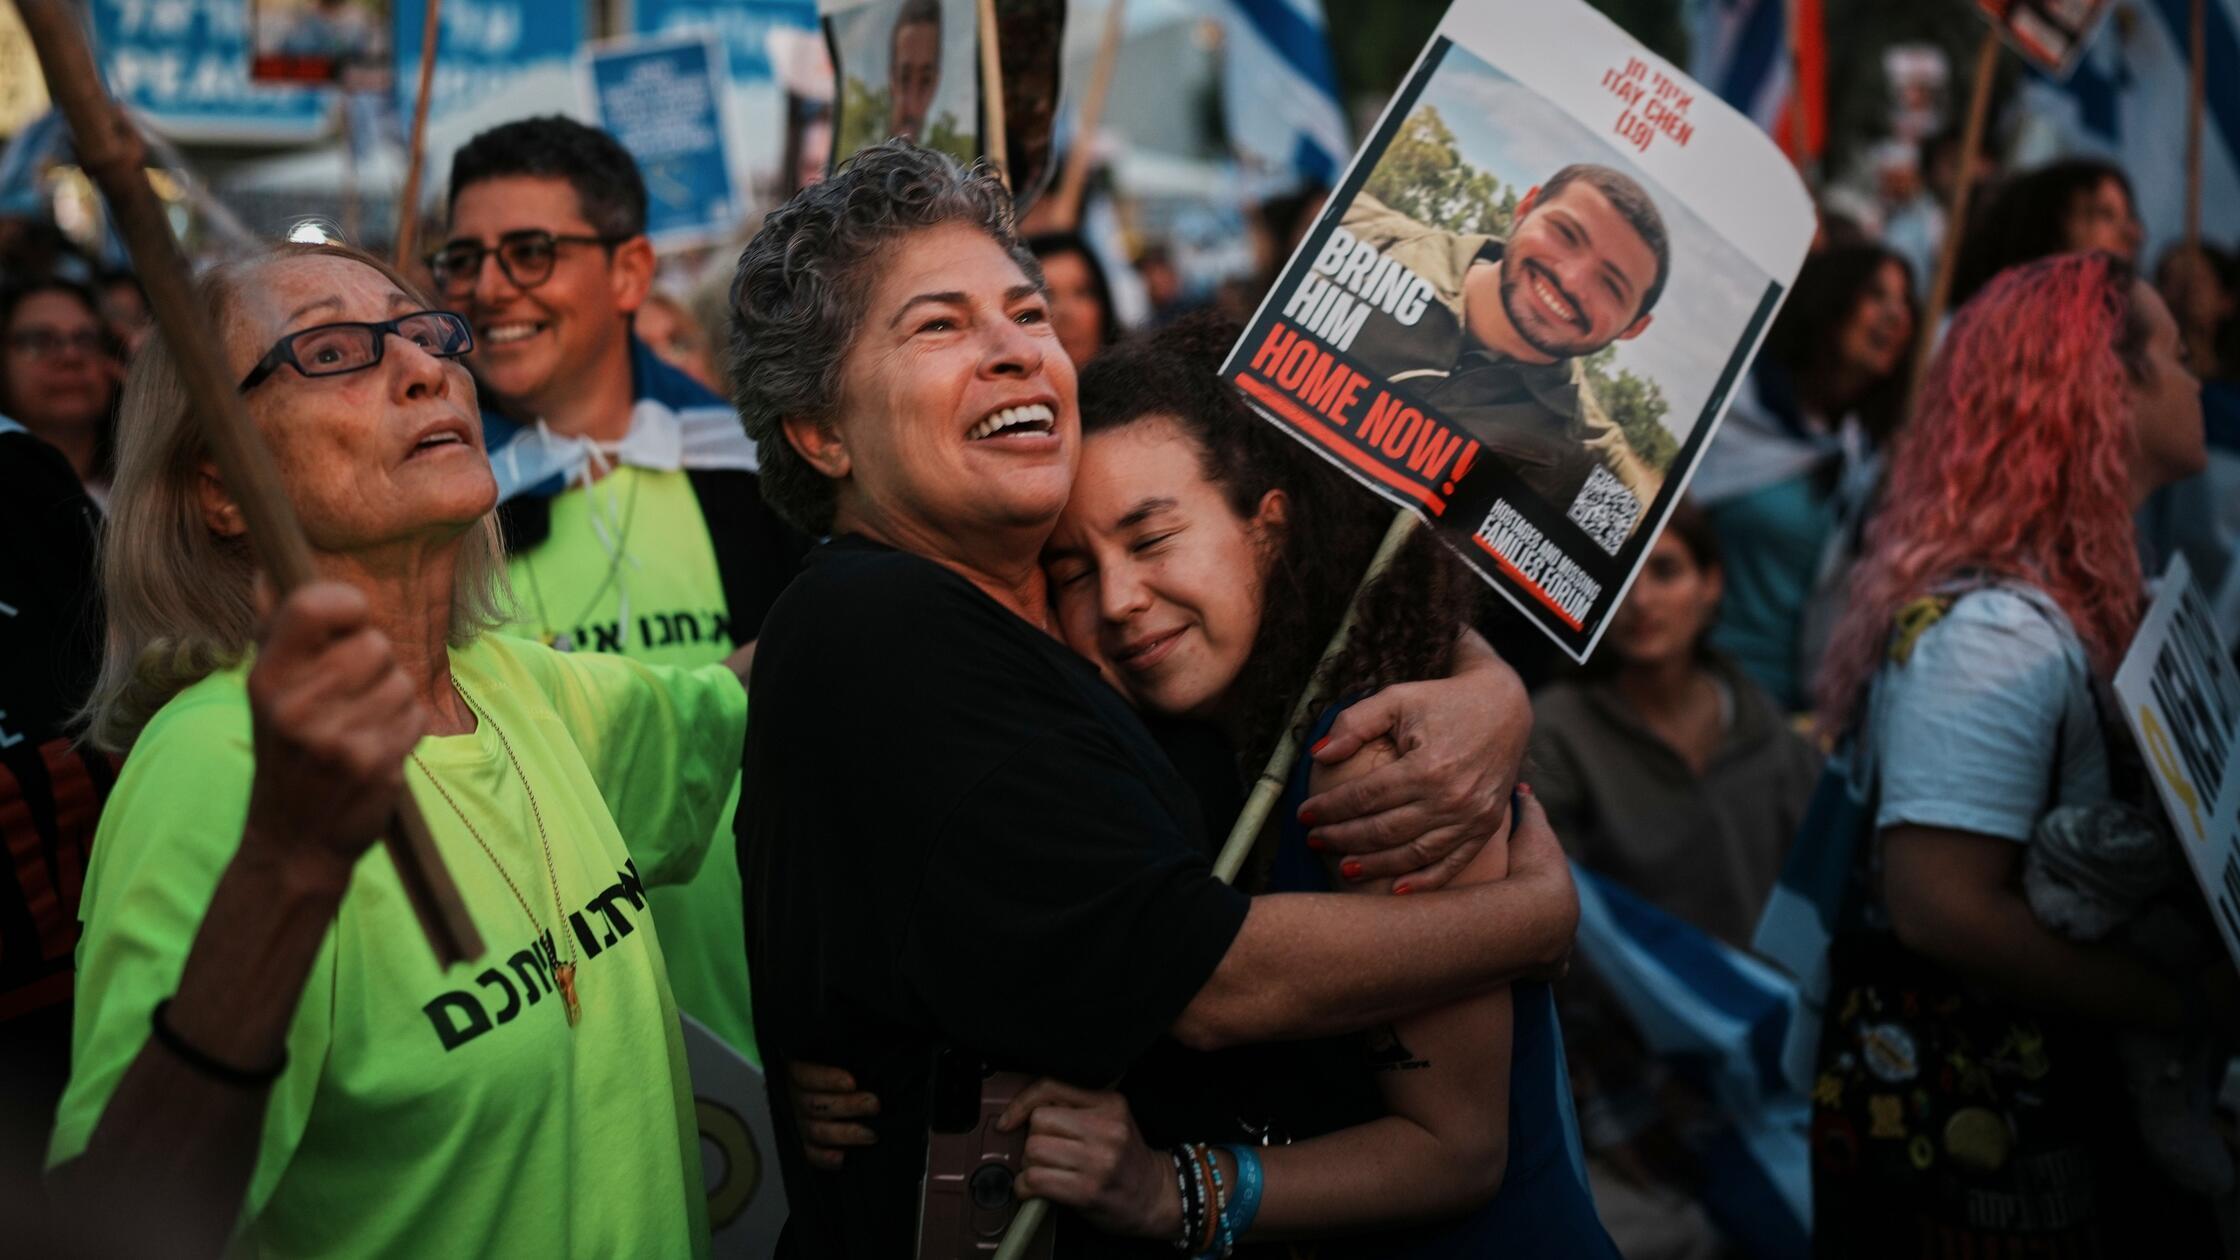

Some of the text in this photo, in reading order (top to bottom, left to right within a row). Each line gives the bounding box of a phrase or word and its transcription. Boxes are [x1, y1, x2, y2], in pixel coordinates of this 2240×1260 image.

[1602, 66, 1694, 147] ITAY CHEN
[1282, 271, 1372, 352] HIM
[1313, 226, 1435, 326] BRING
[1250, 321, 1480, 495] HOME NOW!
[1478, 514, 1594, 624] FAMILIES FORUM
[1489, 498, 1602, 601] HOSTAGES AND MISSING
